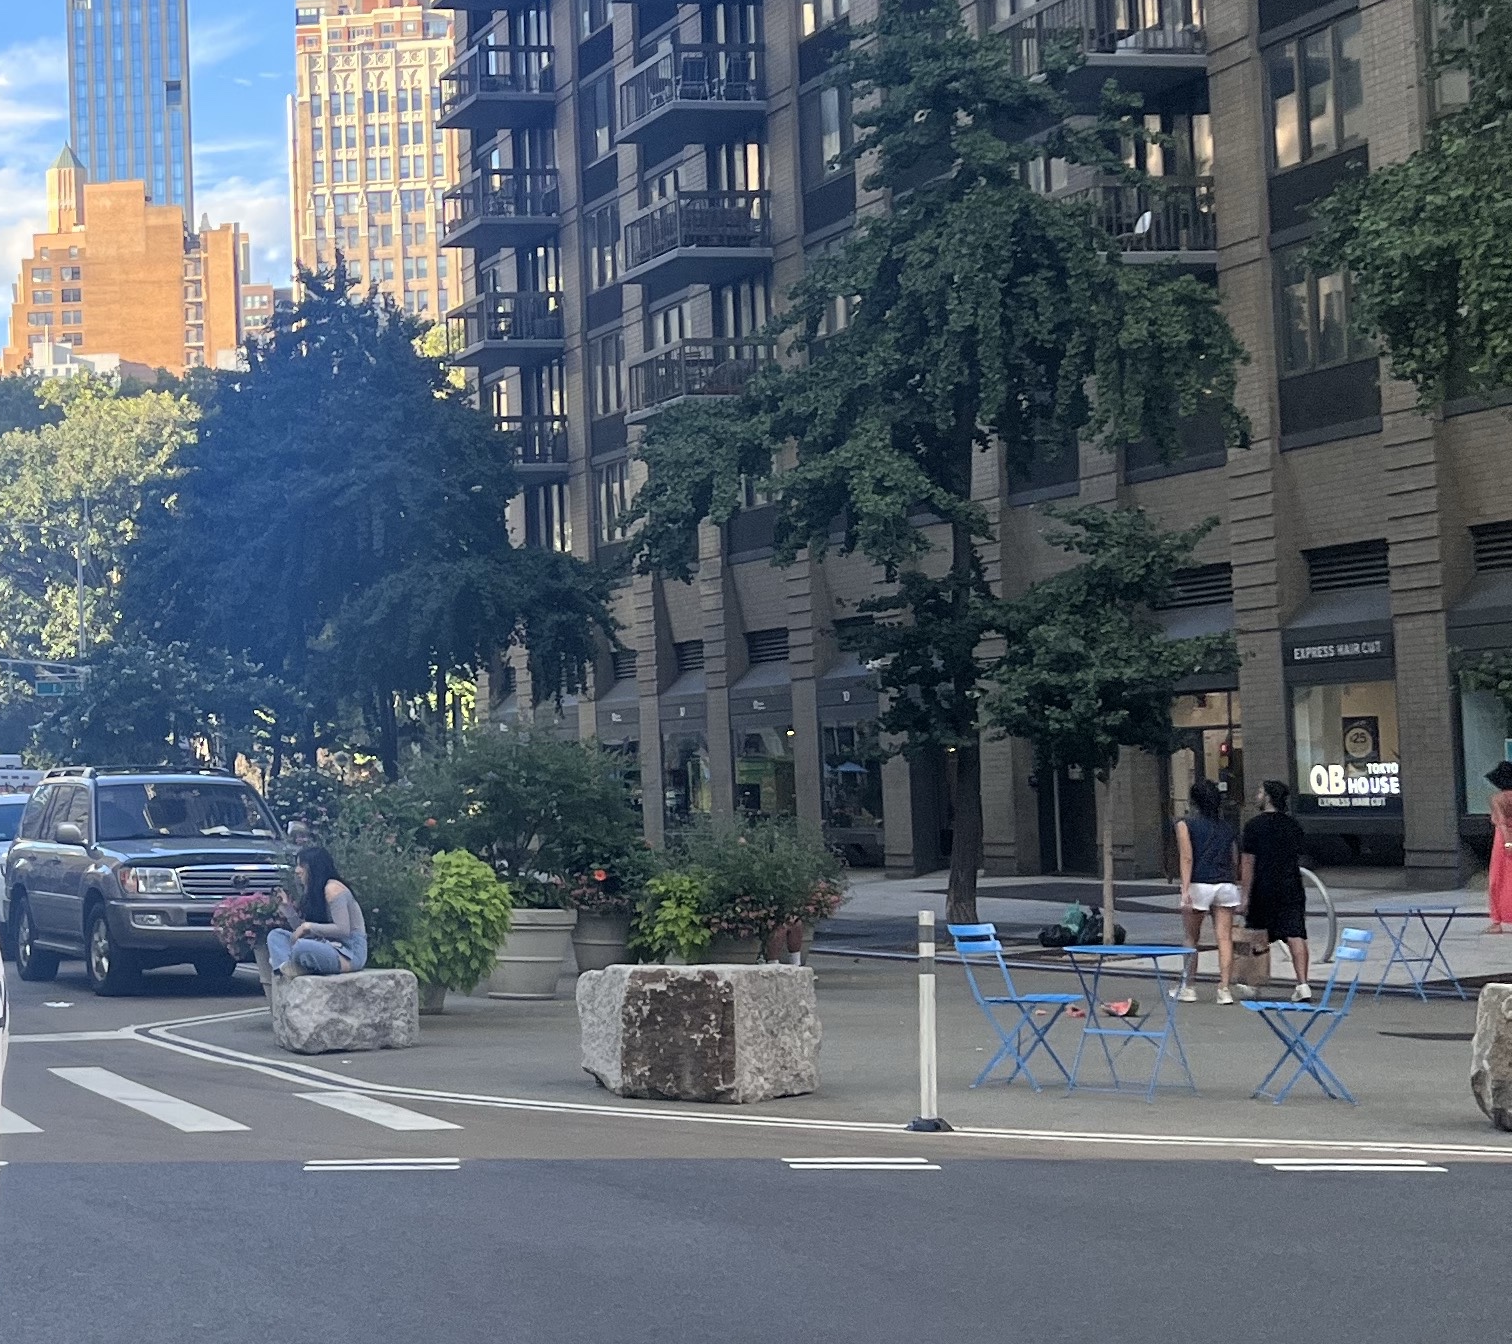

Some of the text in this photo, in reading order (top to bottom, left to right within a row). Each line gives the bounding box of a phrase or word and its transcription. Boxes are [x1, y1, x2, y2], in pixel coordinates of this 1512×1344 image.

[1294, 644, 1335, 660] EXPRESS
[1361, 640, 1381, 654] CUT
[1366, 761, 1400, 775] TOKYO
[1309, 763, 1401, 795] QB HOUSE
